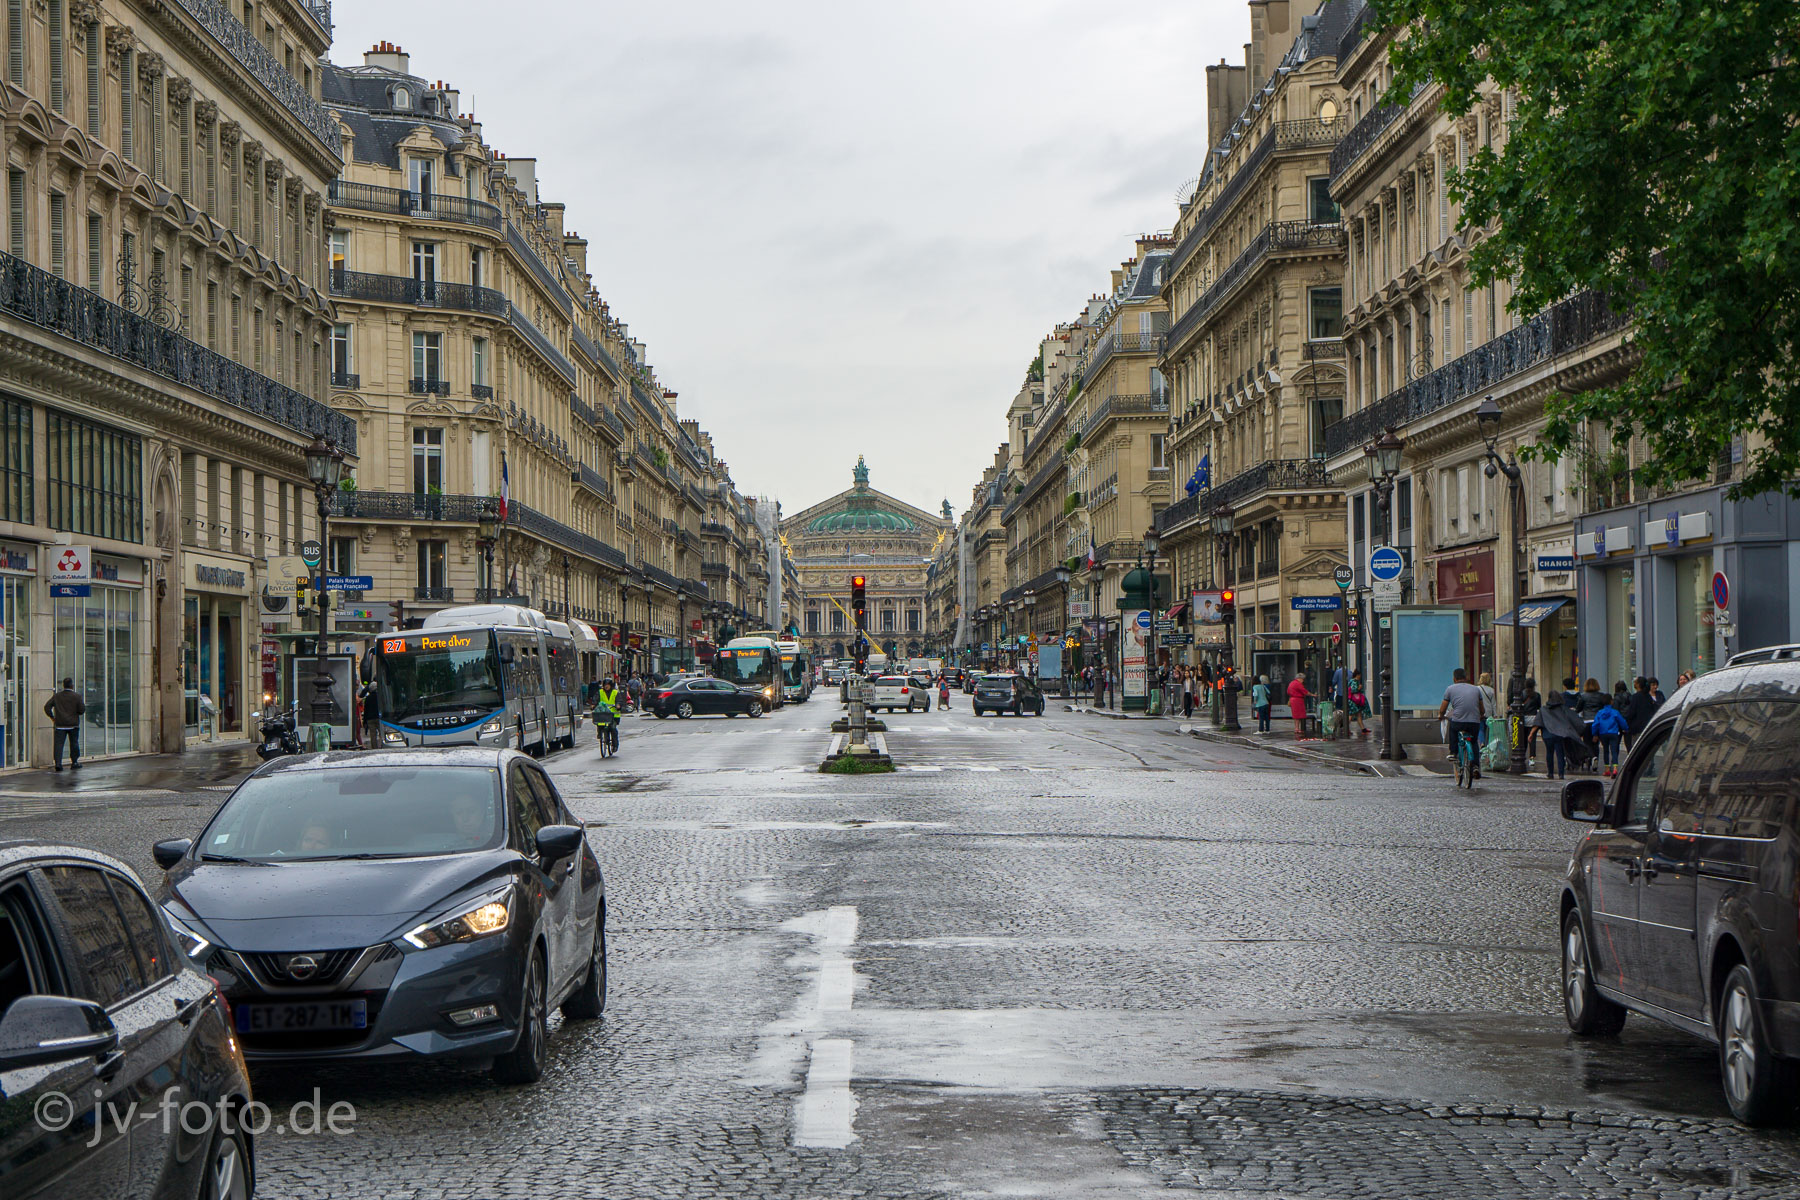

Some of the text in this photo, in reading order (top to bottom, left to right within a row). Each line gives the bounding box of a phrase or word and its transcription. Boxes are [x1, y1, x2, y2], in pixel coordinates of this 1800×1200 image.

[1666, 518, 1677, 531] LCL
[1594, 532, 1604, 543] LCL
[304, 546, 320, 555] BUS
[1336, 570, 1350, 578] BUS
[386, 639, 403, 652] 27
[421, 634, 471, 650] Porte d'Ivry
[425, 716, 458, 726] IVECO
